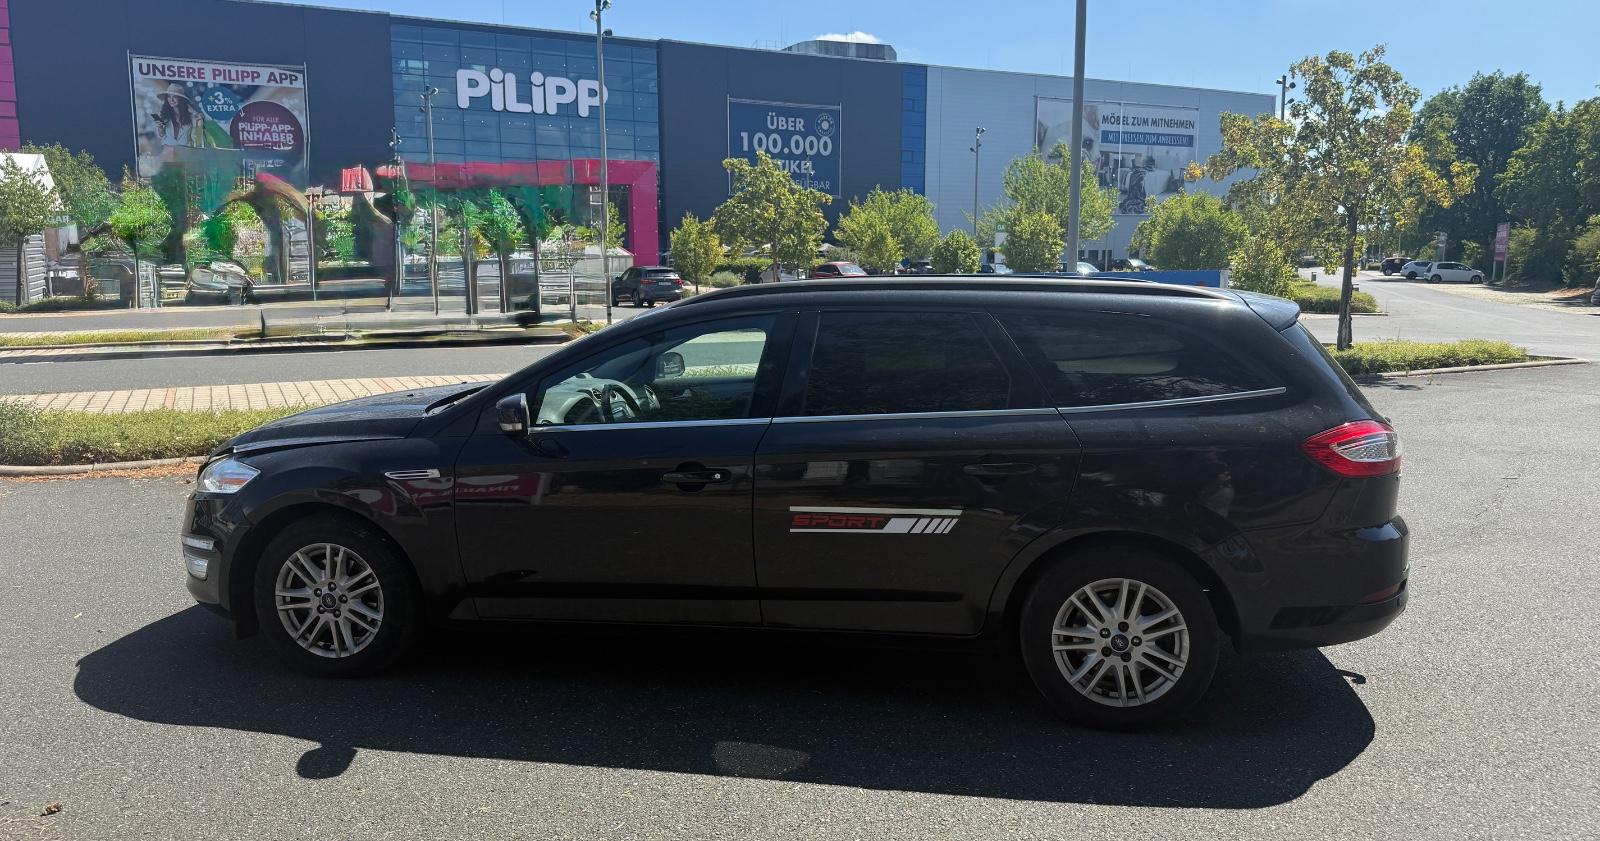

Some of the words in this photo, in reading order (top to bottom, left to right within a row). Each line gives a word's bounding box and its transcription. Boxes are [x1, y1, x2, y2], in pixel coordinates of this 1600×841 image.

[138, 62, 205, 80] UNSERE
[212, 68, 261, 83] PILIPP
[266, 71, 299, 85] APP
[767, 112, 805, 131] ÜBER
[1102, 113, 1129, 126] MÖBEL
[1130, 116, 1149, 127] ZUM
[1150, 118, 1195, 129] MITNEHMEN
[740, 131, 832, 156] 100.000
[772, 159, 816, 174] TIKEL
[795, 178, 830, 190] FÜGBAR
[791, 514, 885, 528] SPORT
